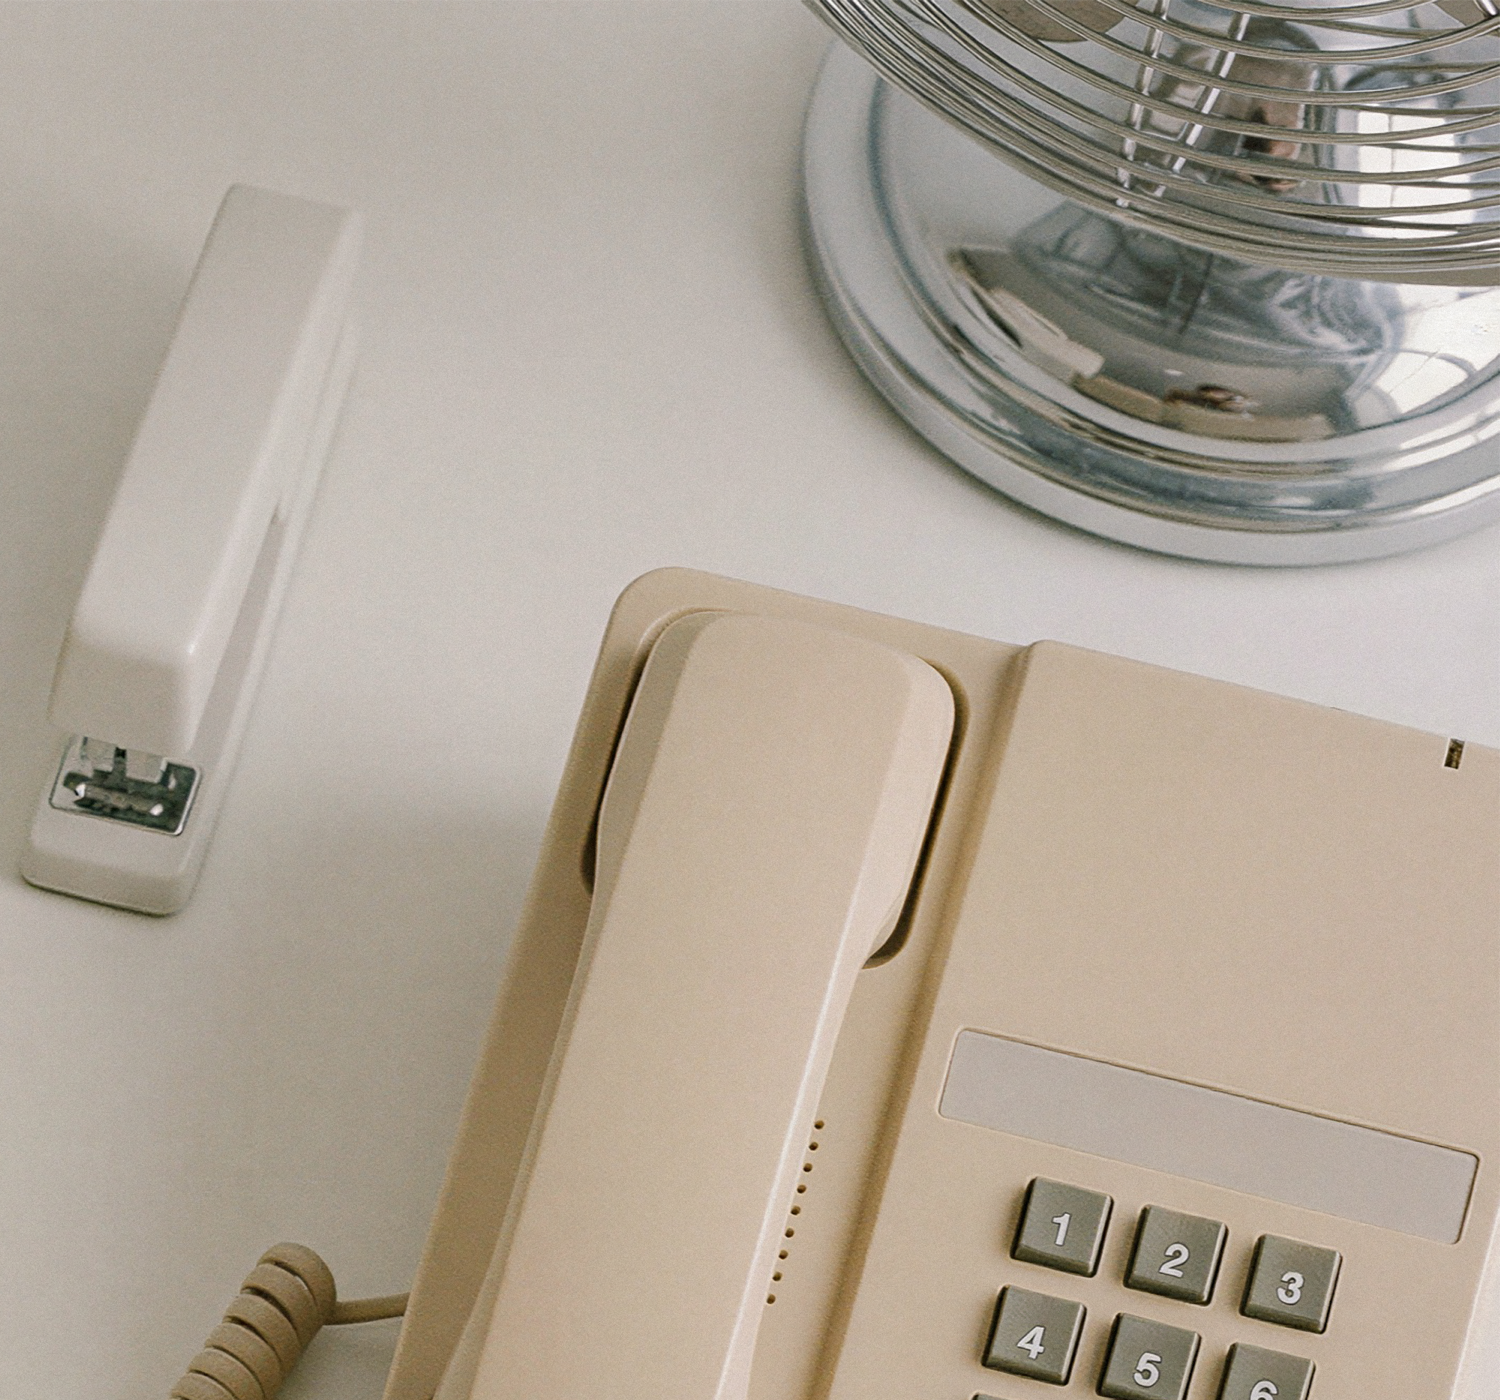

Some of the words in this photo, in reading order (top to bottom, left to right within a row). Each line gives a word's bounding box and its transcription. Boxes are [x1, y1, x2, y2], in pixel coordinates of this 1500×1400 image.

[1053, 1213, 1070, 1245] 1
[1159, 1243, 1189, 1278] 2
[1277, 1271, 1304, 1304] 3
[1017, 1326, 1045, 1359] 4
[1134, 1352, 1161, 1387] 5
